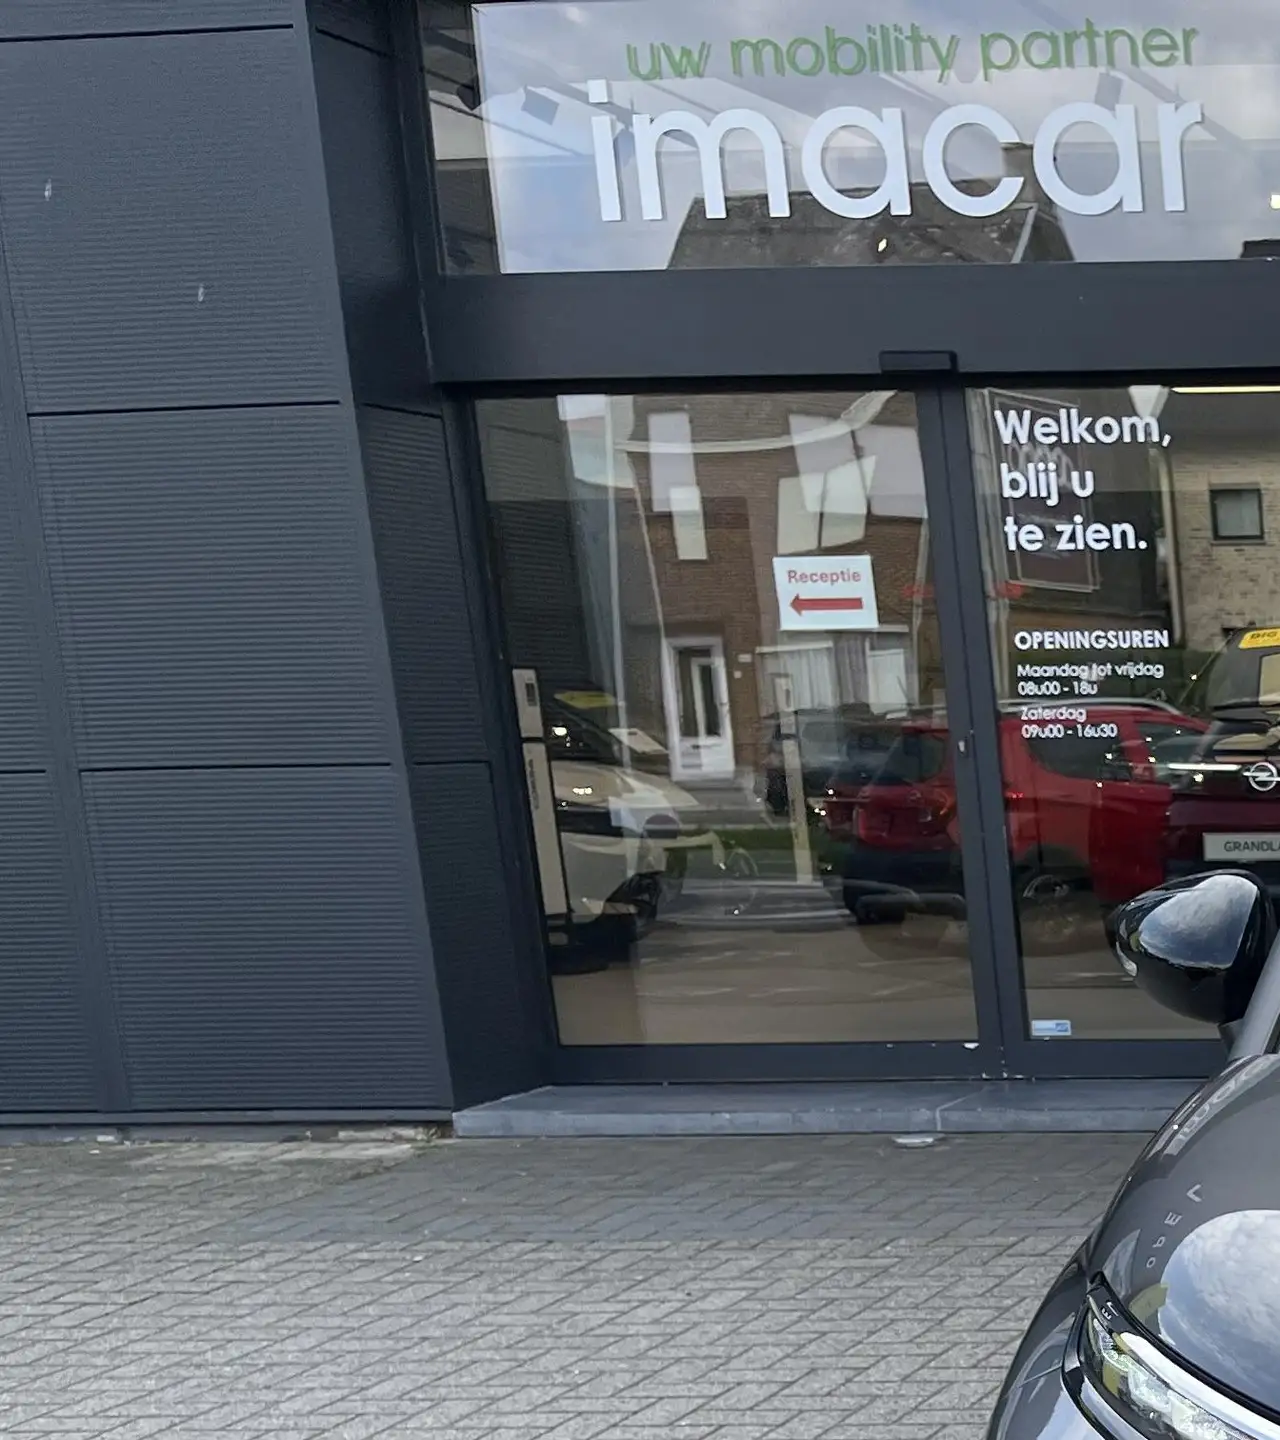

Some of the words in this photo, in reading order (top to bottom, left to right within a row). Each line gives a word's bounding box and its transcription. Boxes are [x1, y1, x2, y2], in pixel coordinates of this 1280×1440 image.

[626, 41, 711, 81] uw
[729, 22, 959, 84] mobility
[979, 18, 1199, 83] partner
[588, 79, 1204, 222] imacar
[993, 407, 1172, 447] Welkom,
[1000, 462, 1060, 507] blij
[1070, 470, 1095, 498] u
[1004, 516, 1045, 551] te
[1055, 514, 1148, 551] zien.
[786, 568, 862, 586] Receptie
[1013, 630, 1170, 650] OPENINGSUREN
[1016, 663, 1089, 681] Maandag
[1091, 662, 1112, 677] tot
[1114, 661, 1165, 679] vrijdag
[1017, 681, 1061, 696] 08u00
[1073, 680, 1099, 696] 18u
[1020, 706, 1088, 723] Zaterdag
[1021, 724, 1065, 739] 09u00
[1077, 723, 1119, 738] 16u30
